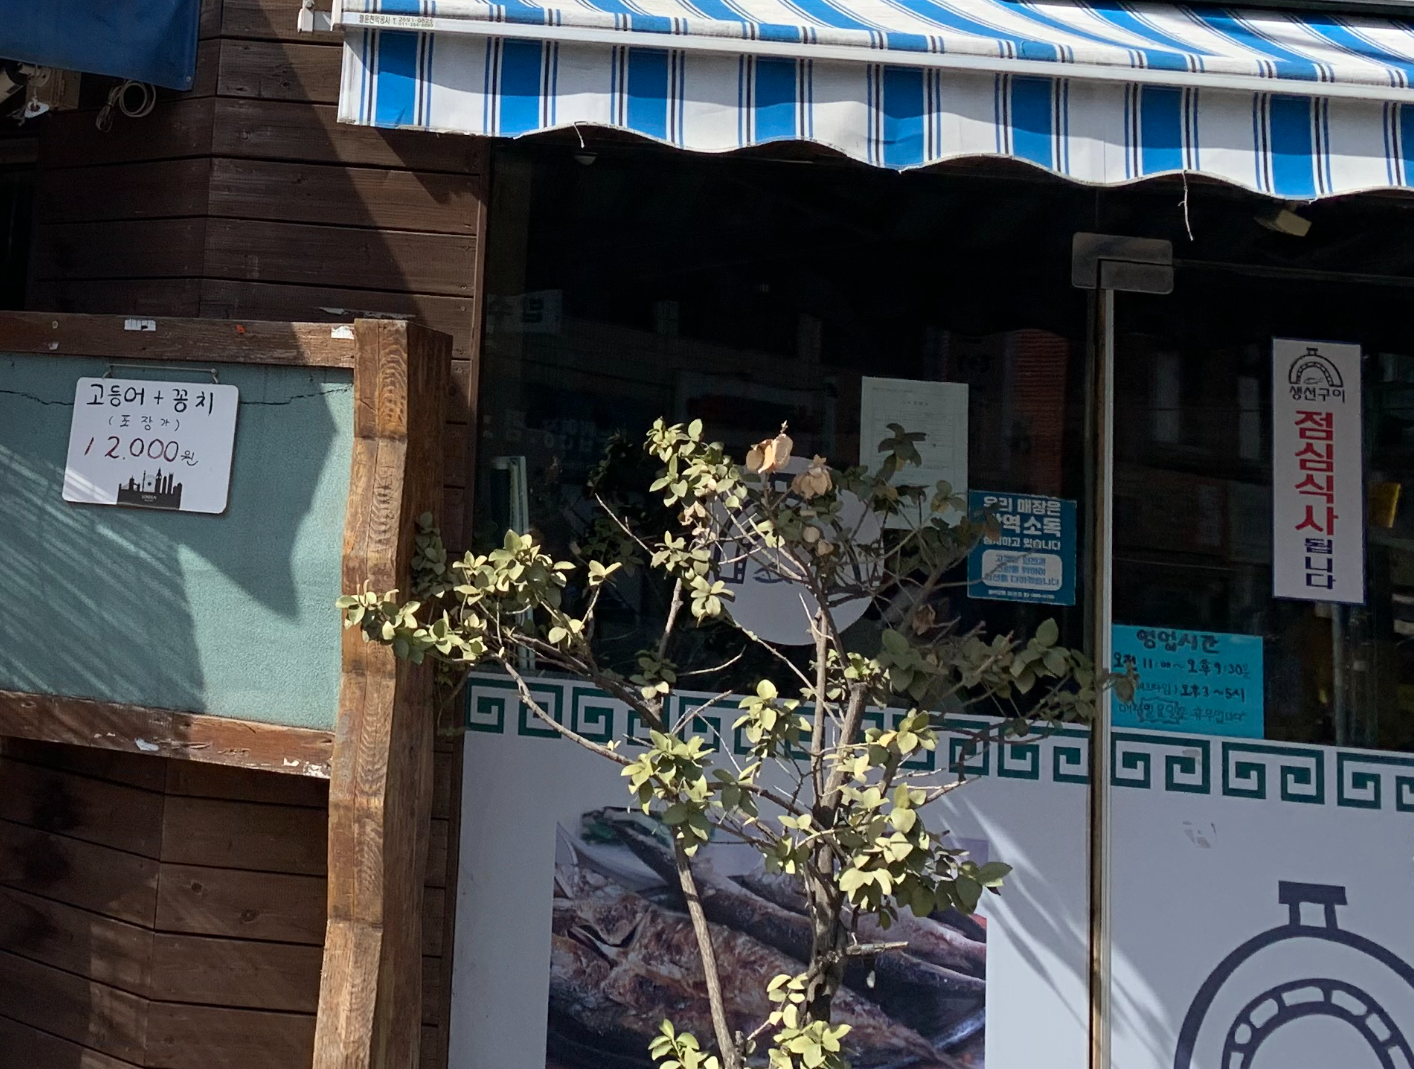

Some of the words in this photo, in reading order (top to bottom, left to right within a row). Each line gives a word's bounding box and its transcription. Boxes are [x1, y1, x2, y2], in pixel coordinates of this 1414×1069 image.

[86, 383, 145, 407] 고등어
[172, 388, 214, 417] 꽁치
[1289, 385, 1346, 404] 생선구이
[1017, 498, 1061, 516] 매장은
[1023, 516, 1061, 537] 소독
[1023, 538, 1061, 550] 있습니다
[1137, 629, 1220, 654] 영업시간
